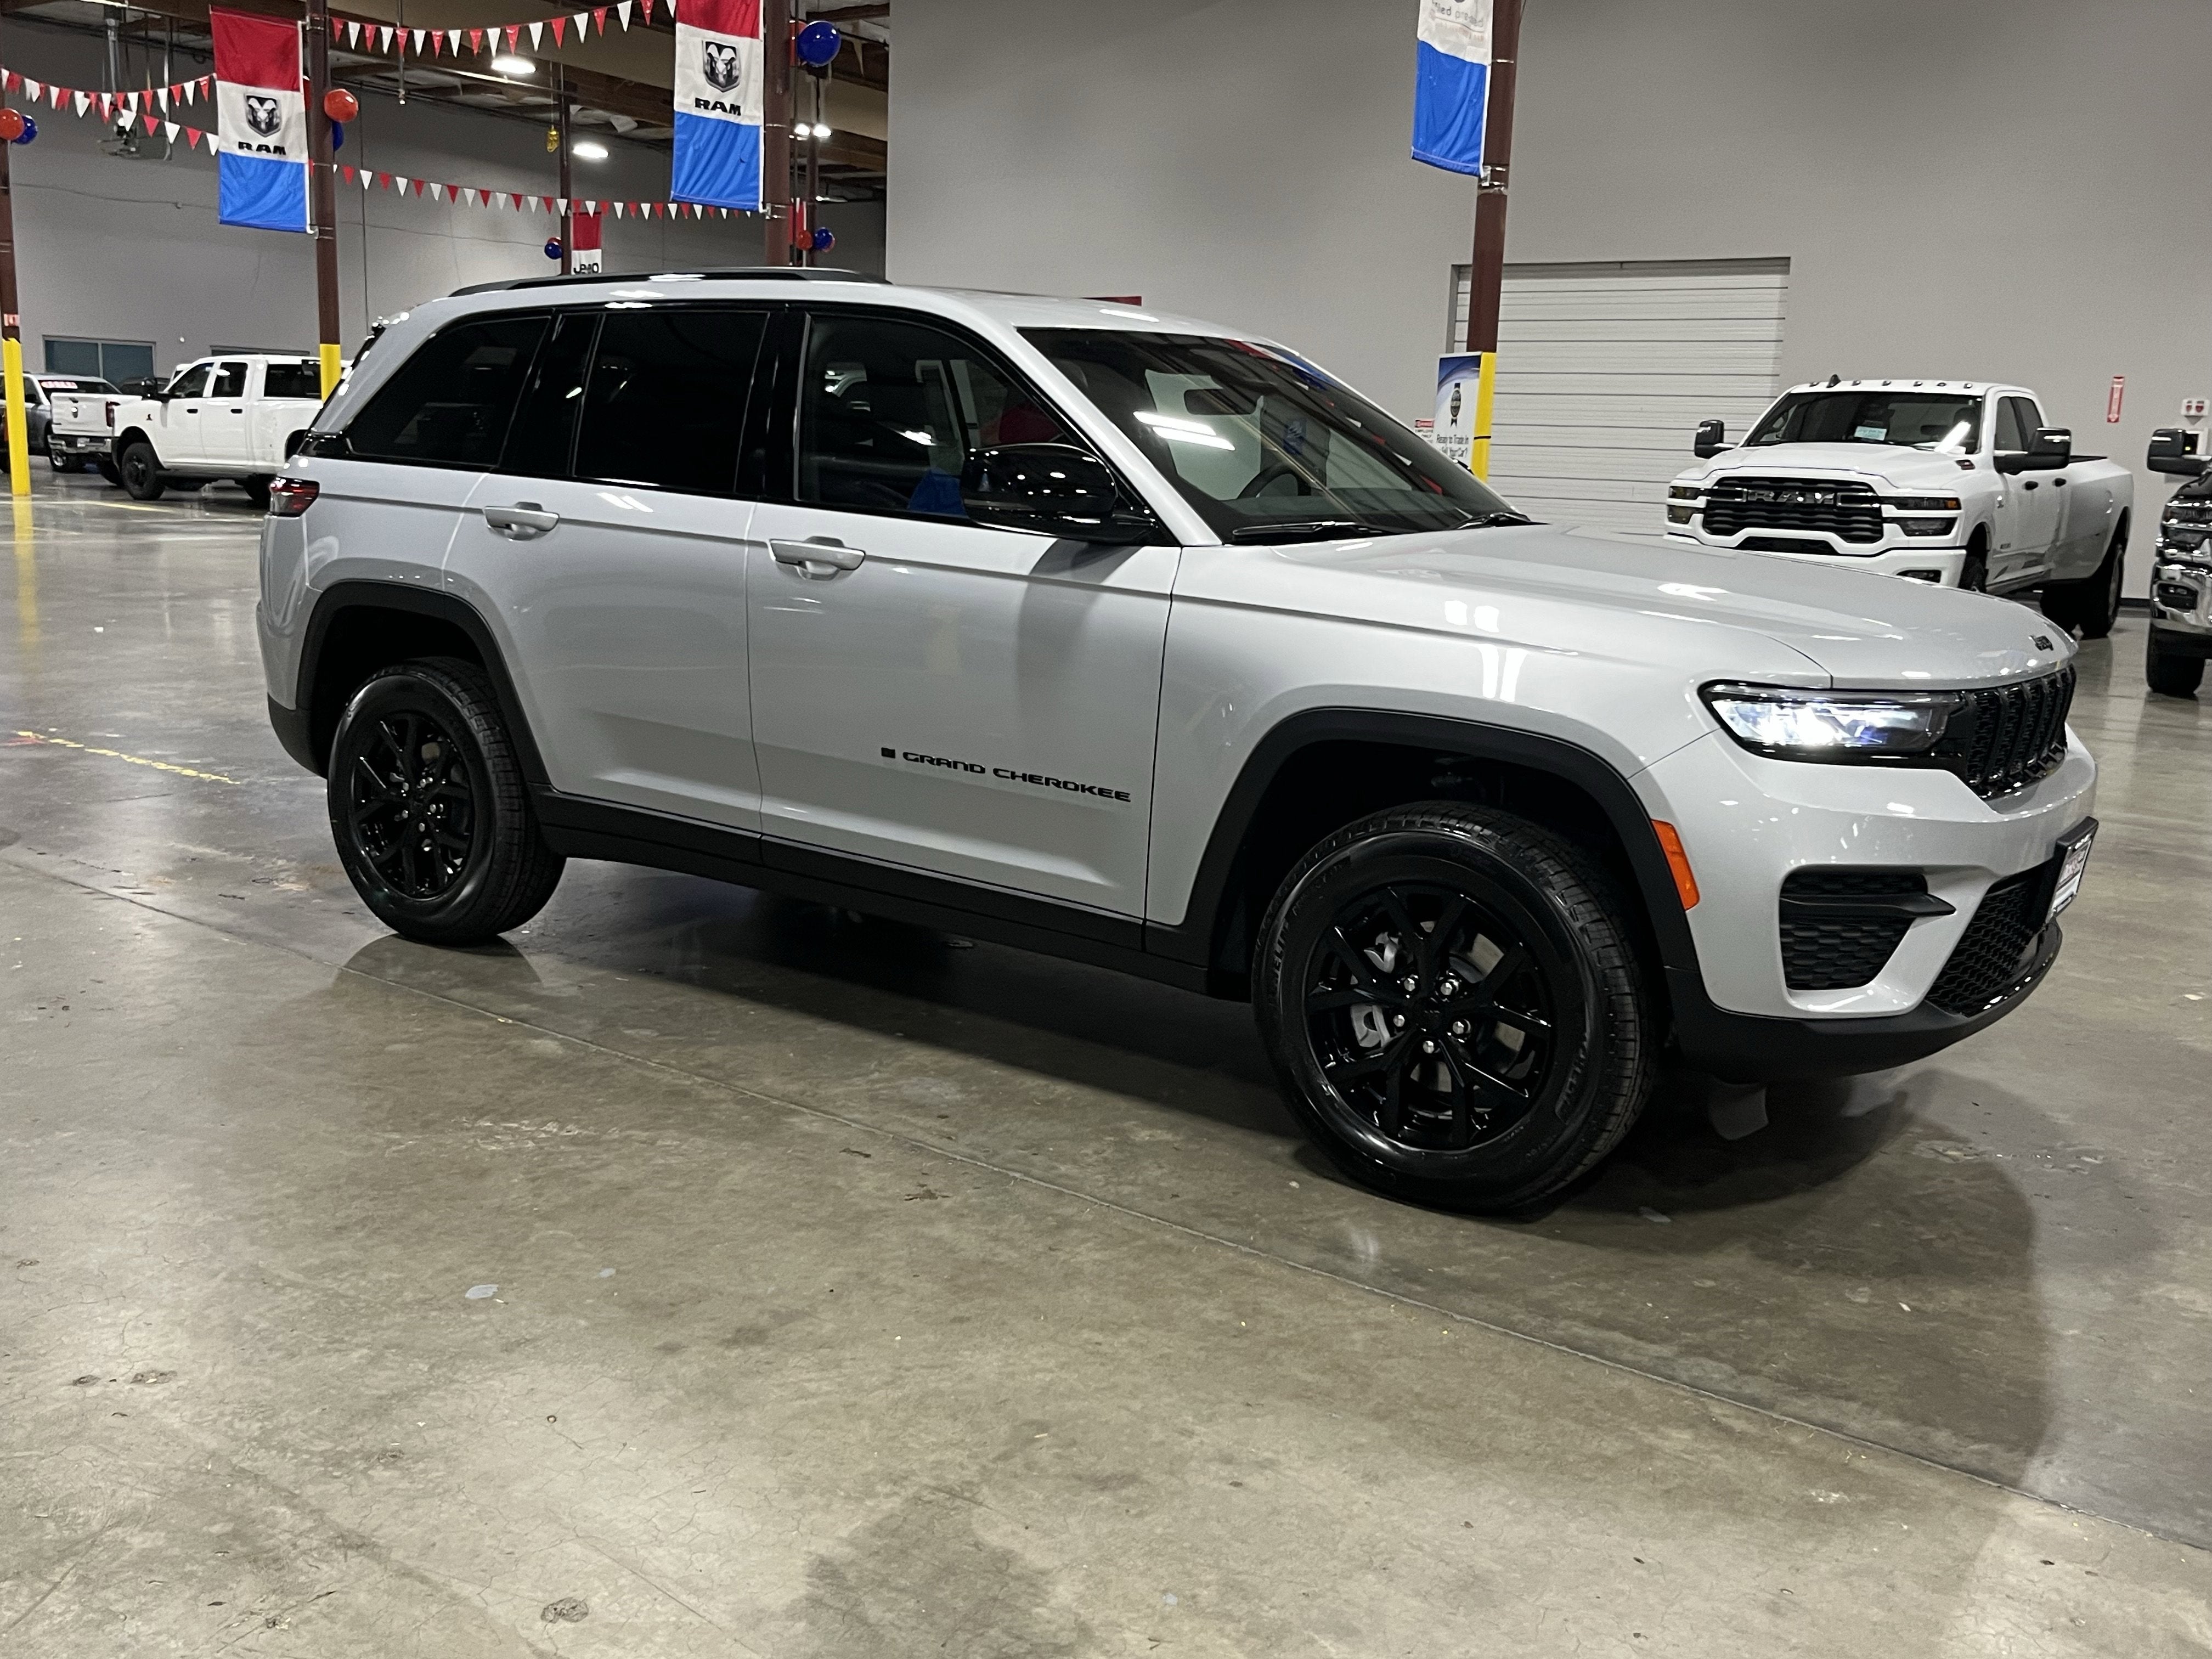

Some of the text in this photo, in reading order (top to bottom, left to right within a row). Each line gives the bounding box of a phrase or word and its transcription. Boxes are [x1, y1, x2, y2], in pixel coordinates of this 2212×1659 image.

[695, 97, 742, 116] RAM
[238, 141, 286, 155] RAM
[1748, 489, 1835, 504] RAM
[902, 752, 1131, 803] GRAND CHEROKEE
